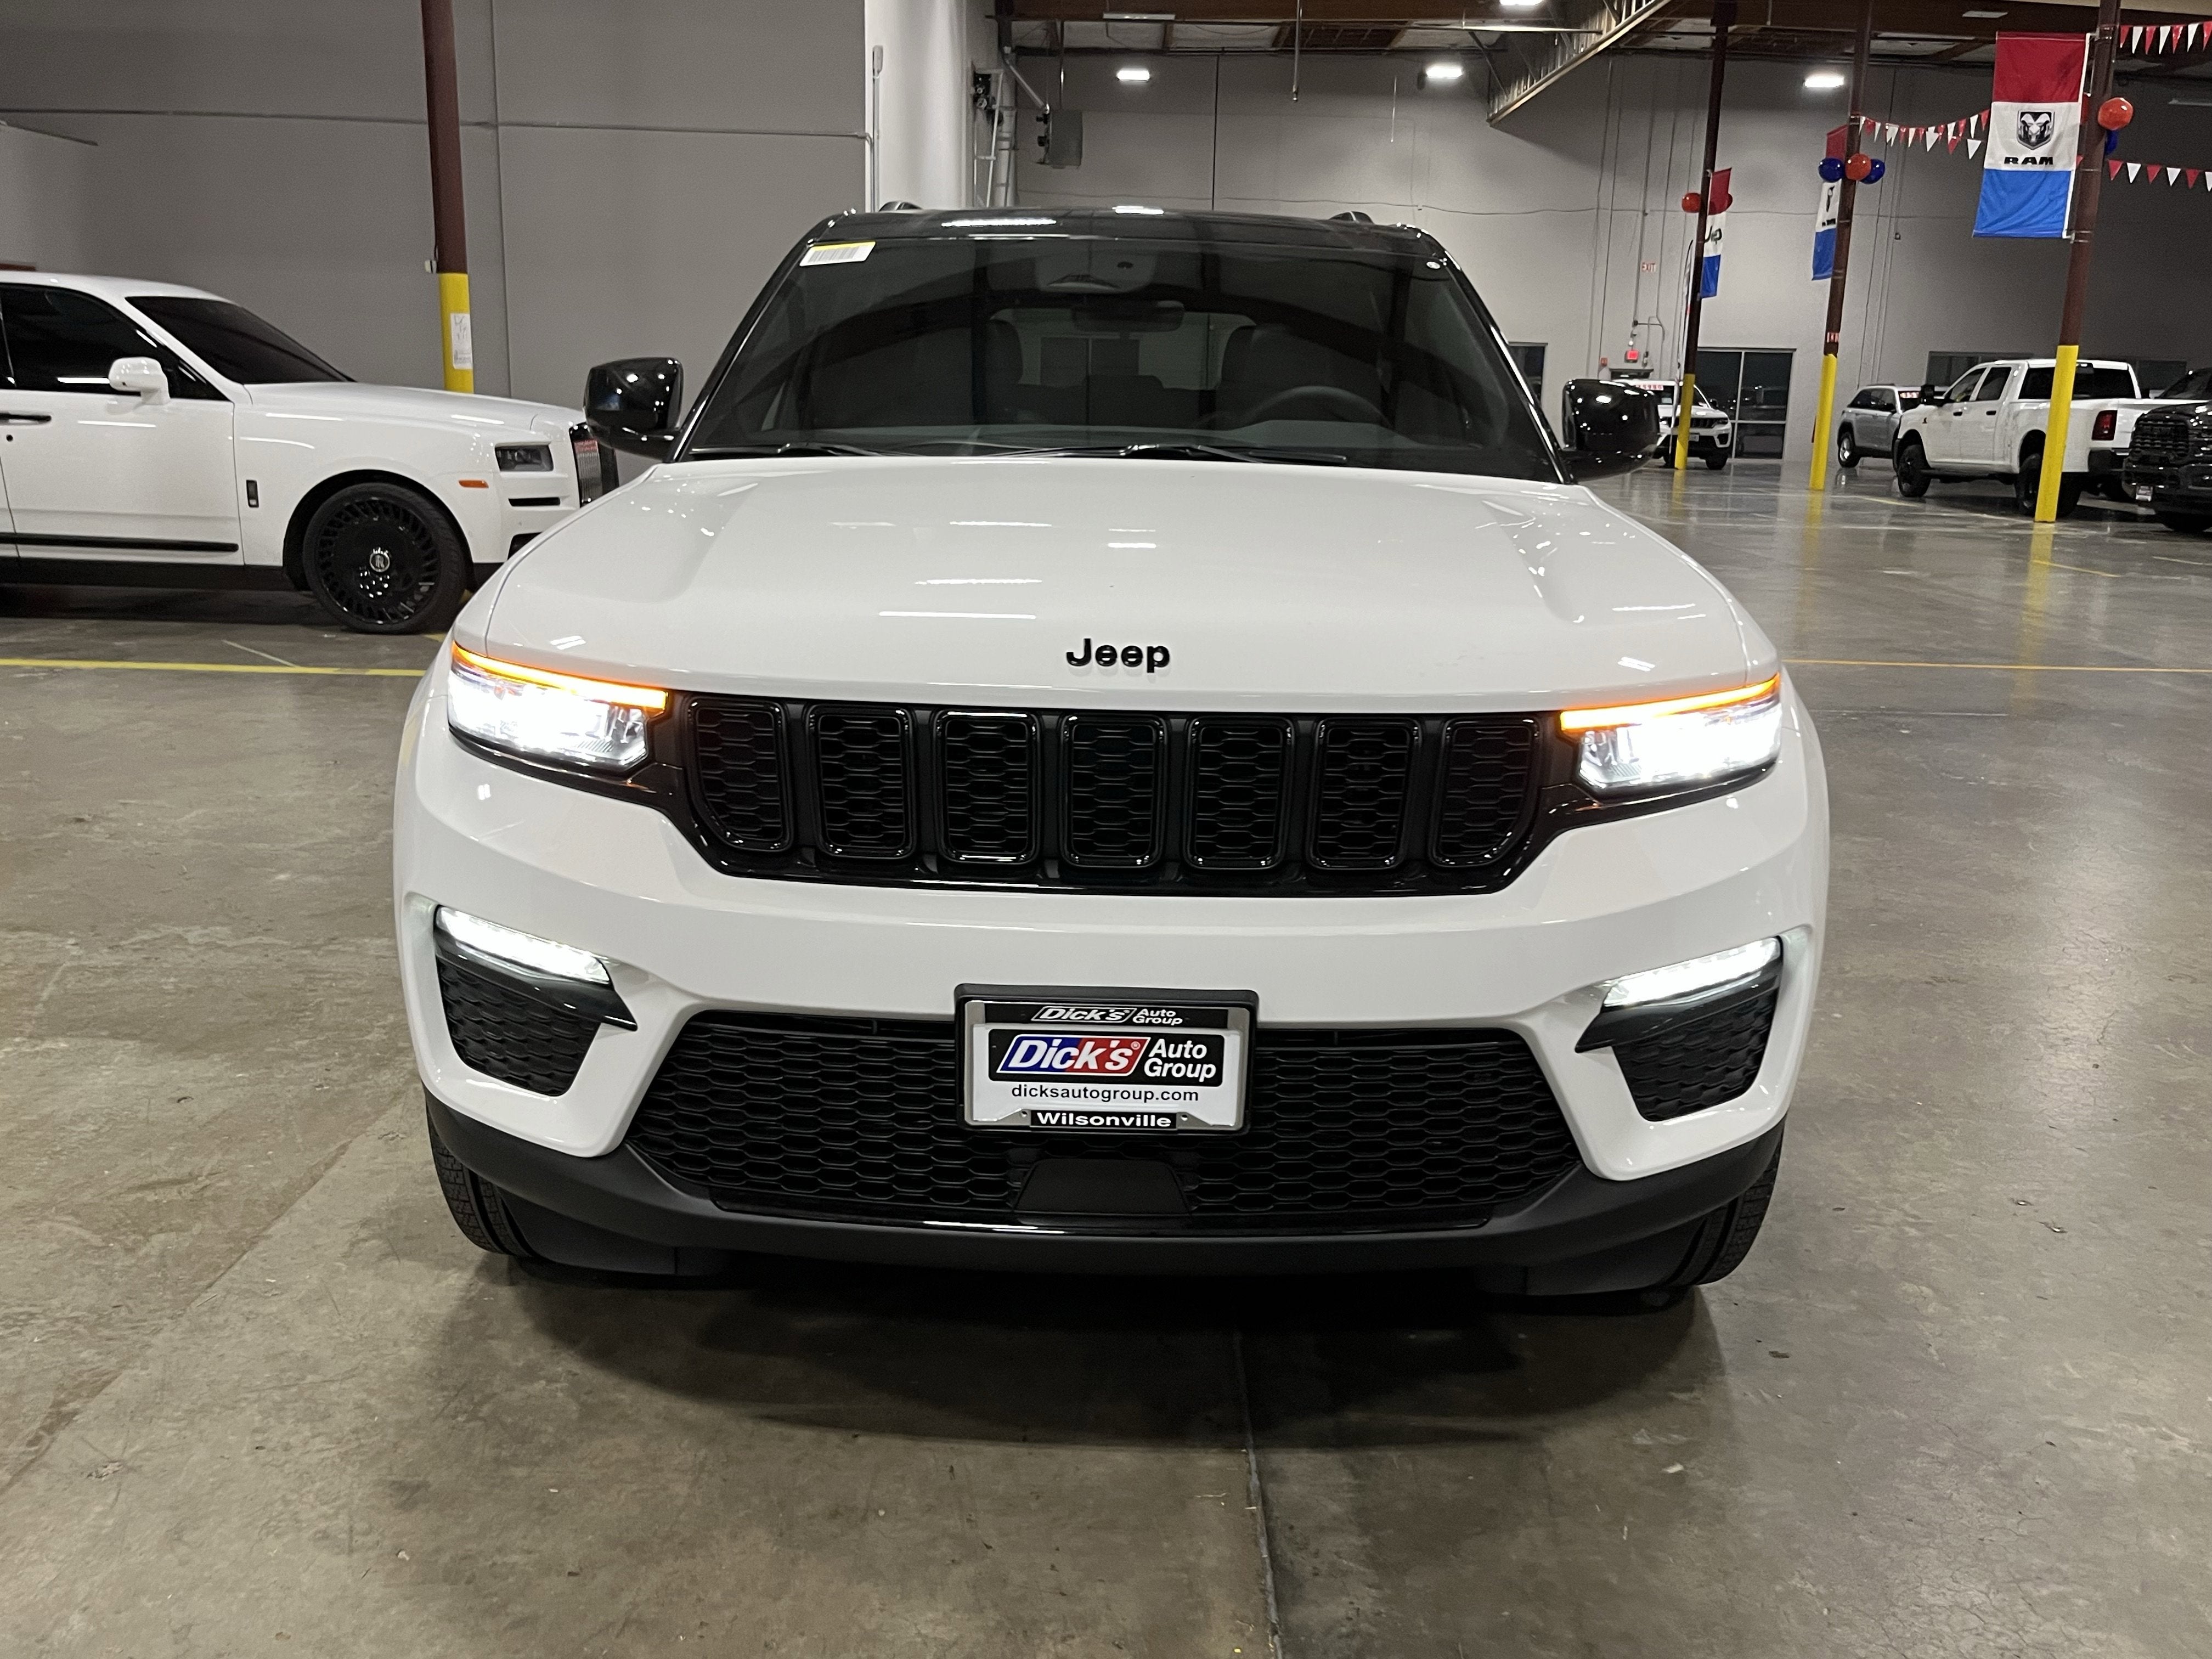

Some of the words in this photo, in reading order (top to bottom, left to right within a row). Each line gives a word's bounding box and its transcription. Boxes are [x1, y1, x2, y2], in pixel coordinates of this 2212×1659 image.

[2004, 156, 2053, 165] RAM
[1066, 638, 1170, 673] Jeep
[1039, 1008, 1125, 1021] Dick's
[1132, 1015, 1183, 1025] Group
[1136, 1008, 1176, 1017] Auto
[1008, 1039, 1133, 1070] Dick's
[1148, 1038, 1207, 1059] Auto
[1144, 1058, 1217, 1082] Group
[1012, 1084, 1198, 1102] dicksautogroup.com
[1037, 1112, 1171, 1127] Wilsonville
